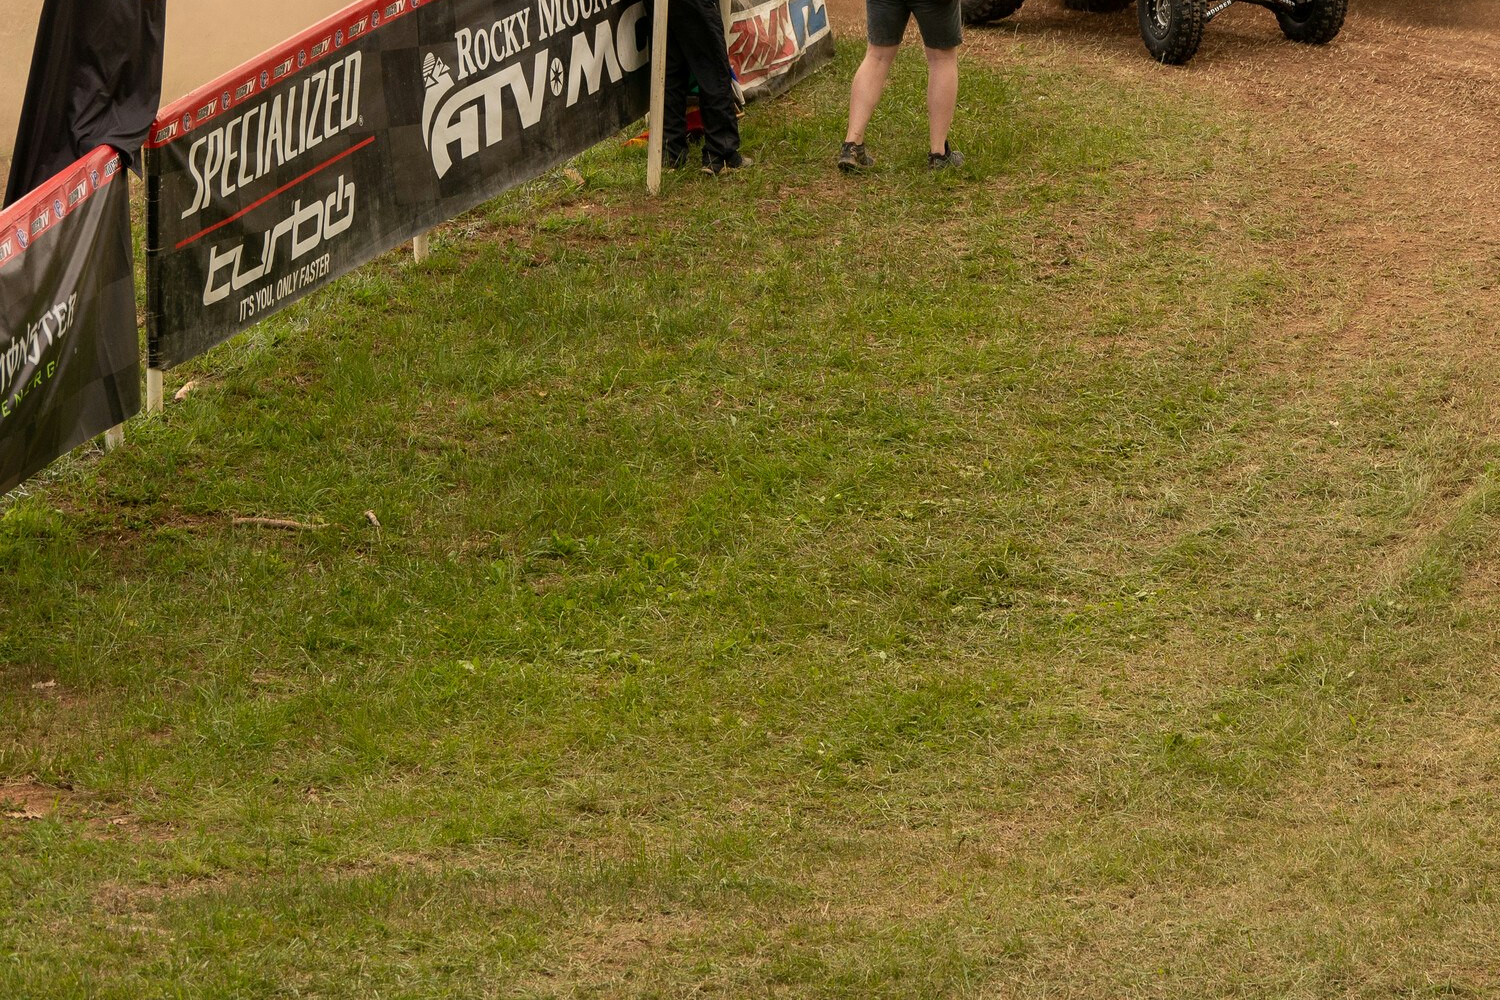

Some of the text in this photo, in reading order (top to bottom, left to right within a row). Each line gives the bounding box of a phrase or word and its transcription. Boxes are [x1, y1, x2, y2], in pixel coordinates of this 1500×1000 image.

[454, 7, 530, 80] ROCKY
[181, 50, 362, 220] SPECIALIZED
[431, 48, 549, 180] ATV
[203, 174, 356, 307] turbo
[239, 252, 331, 323] IT'S YOU, ONLY FASTER
